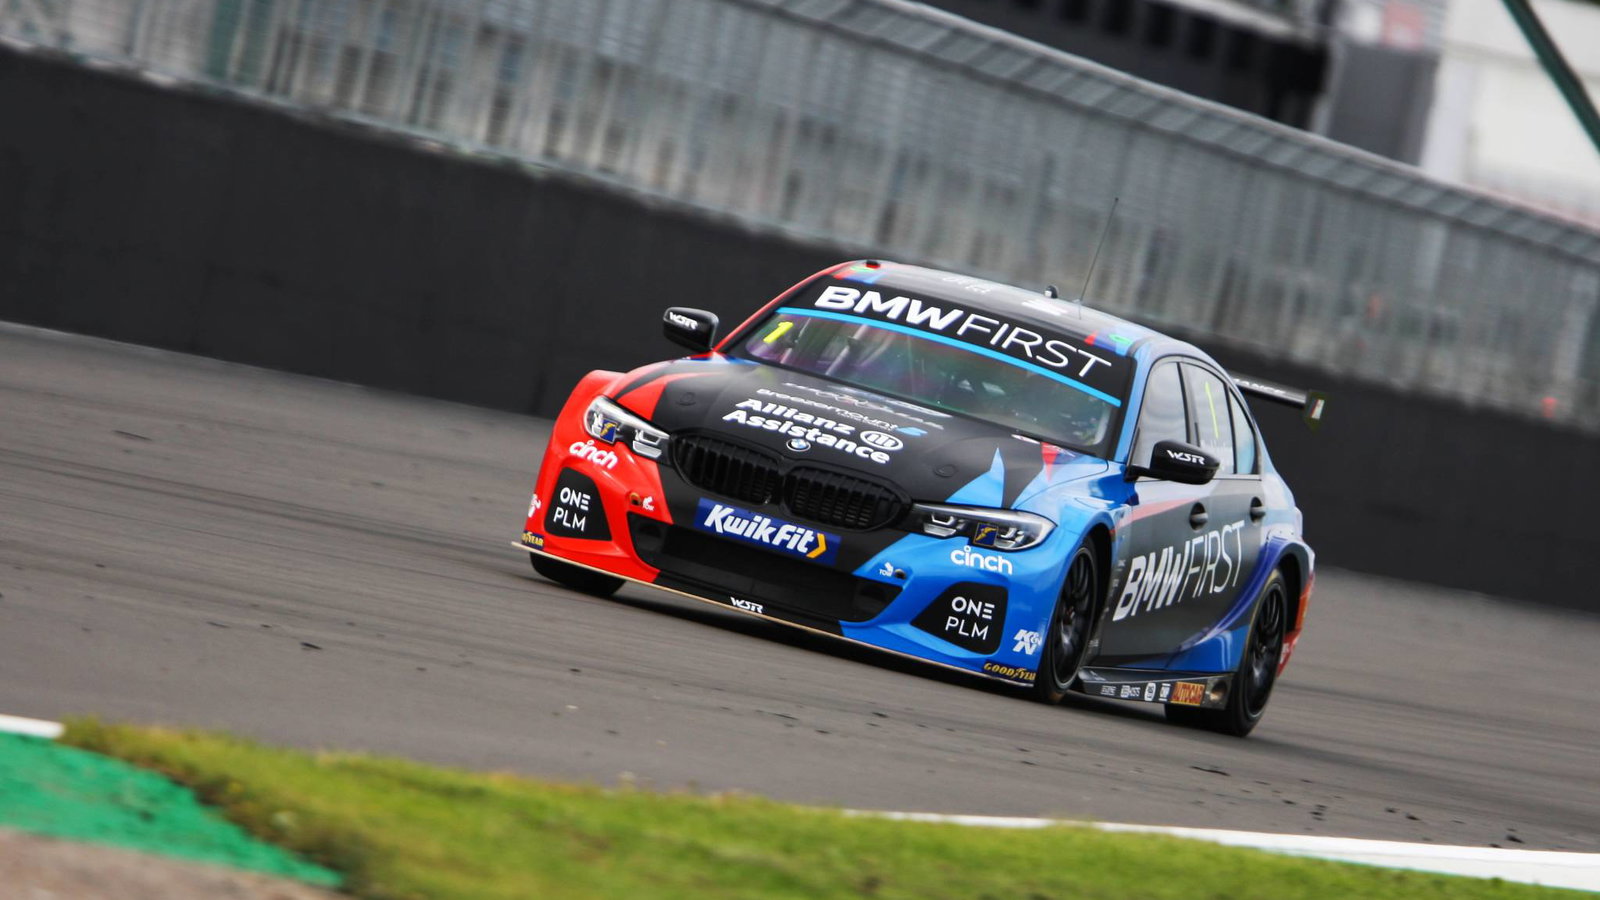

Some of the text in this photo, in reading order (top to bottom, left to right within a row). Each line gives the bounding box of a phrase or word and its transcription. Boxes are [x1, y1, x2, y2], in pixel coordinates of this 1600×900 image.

[669, 311, 699, 330] WSR
[763, 321, 794, 344] 1
[735, 398, 856, 435] Allianz
[722, 409, 891, 464] Assistance
[568, 440, 618, 470] cinch
[1167, 449, 1205, 465] WSR
[560, 486, 591, 511] ONE
[553, 506, 587, 532] PLM
[950, 545, 1013, 575] cinch
[730, 596, 763, 614] WSR
[951, 596, 996, 620] ONE
[944, 615, 990, 641] PLM
